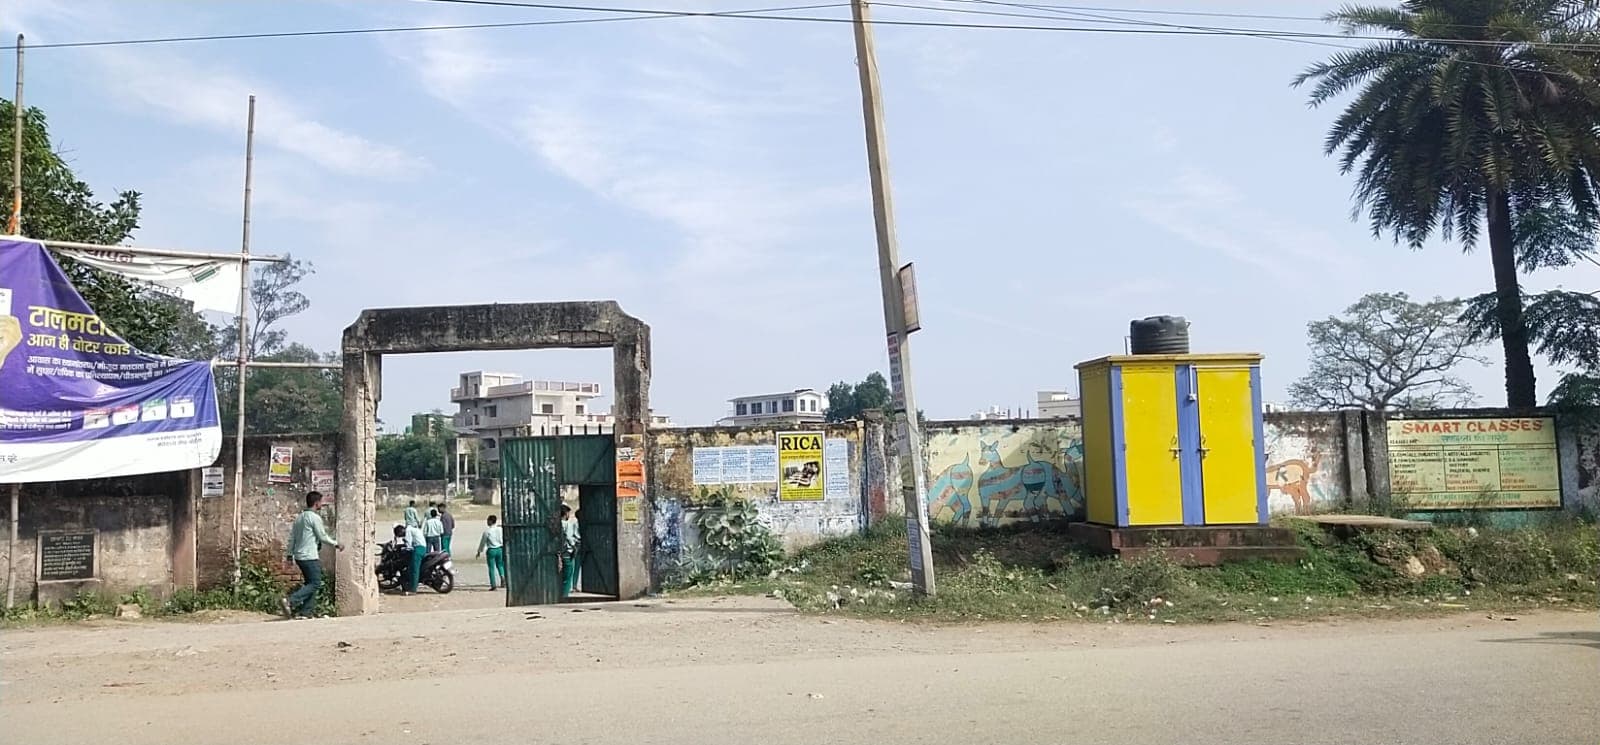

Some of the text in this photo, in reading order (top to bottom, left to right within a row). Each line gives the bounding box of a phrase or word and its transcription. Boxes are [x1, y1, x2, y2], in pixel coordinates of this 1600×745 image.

[27, 333, 56, 348] आज
[58, 332, 70, 351] ही
[72, 336, 101, 354] वोटर
[1401, 419, 1544, 434] SMART CLASSES
[780, 436, 822, 451] RICA
